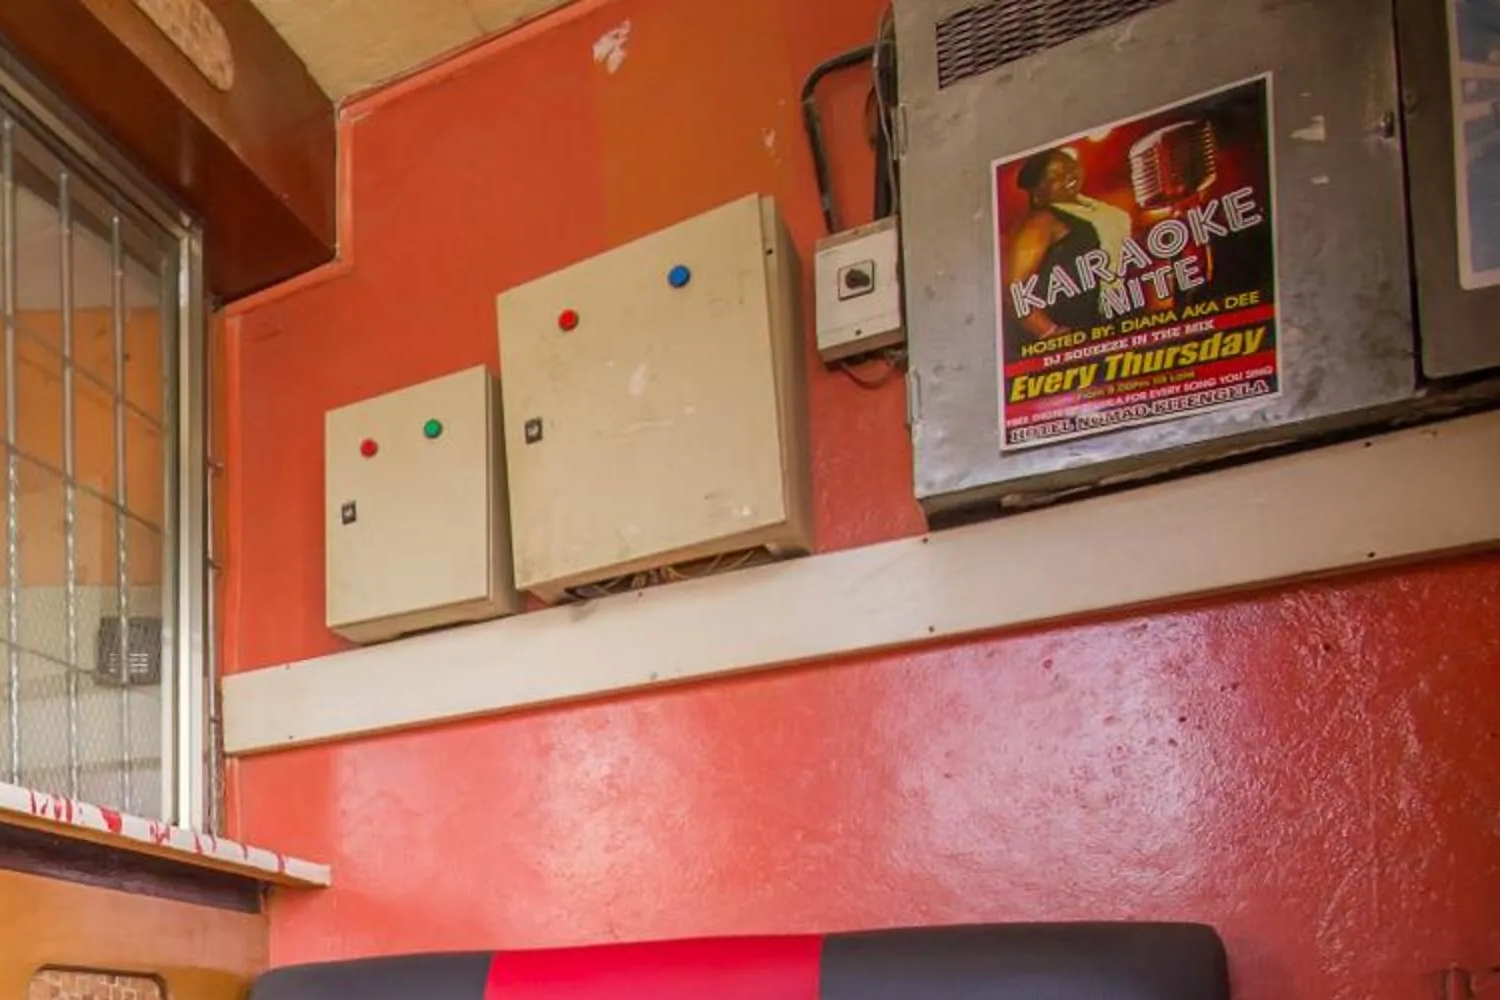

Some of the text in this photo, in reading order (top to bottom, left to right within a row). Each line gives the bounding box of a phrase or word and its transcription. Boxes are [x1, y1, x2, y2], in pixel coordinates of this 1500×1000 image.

[1009, 186, 1263, 319] KARAOKE
[1099, 255, 1206, 320] NITE
[1021, 290, 1261, 357] HOSTED BY: DIANA AKA DEE
[1043, 318, 1215, 367] DJ SQUEEZE IN THE MIX
[1010, 326, 1266, 402] Every Thursday
[1219, 372, 1243, 385] YOU
